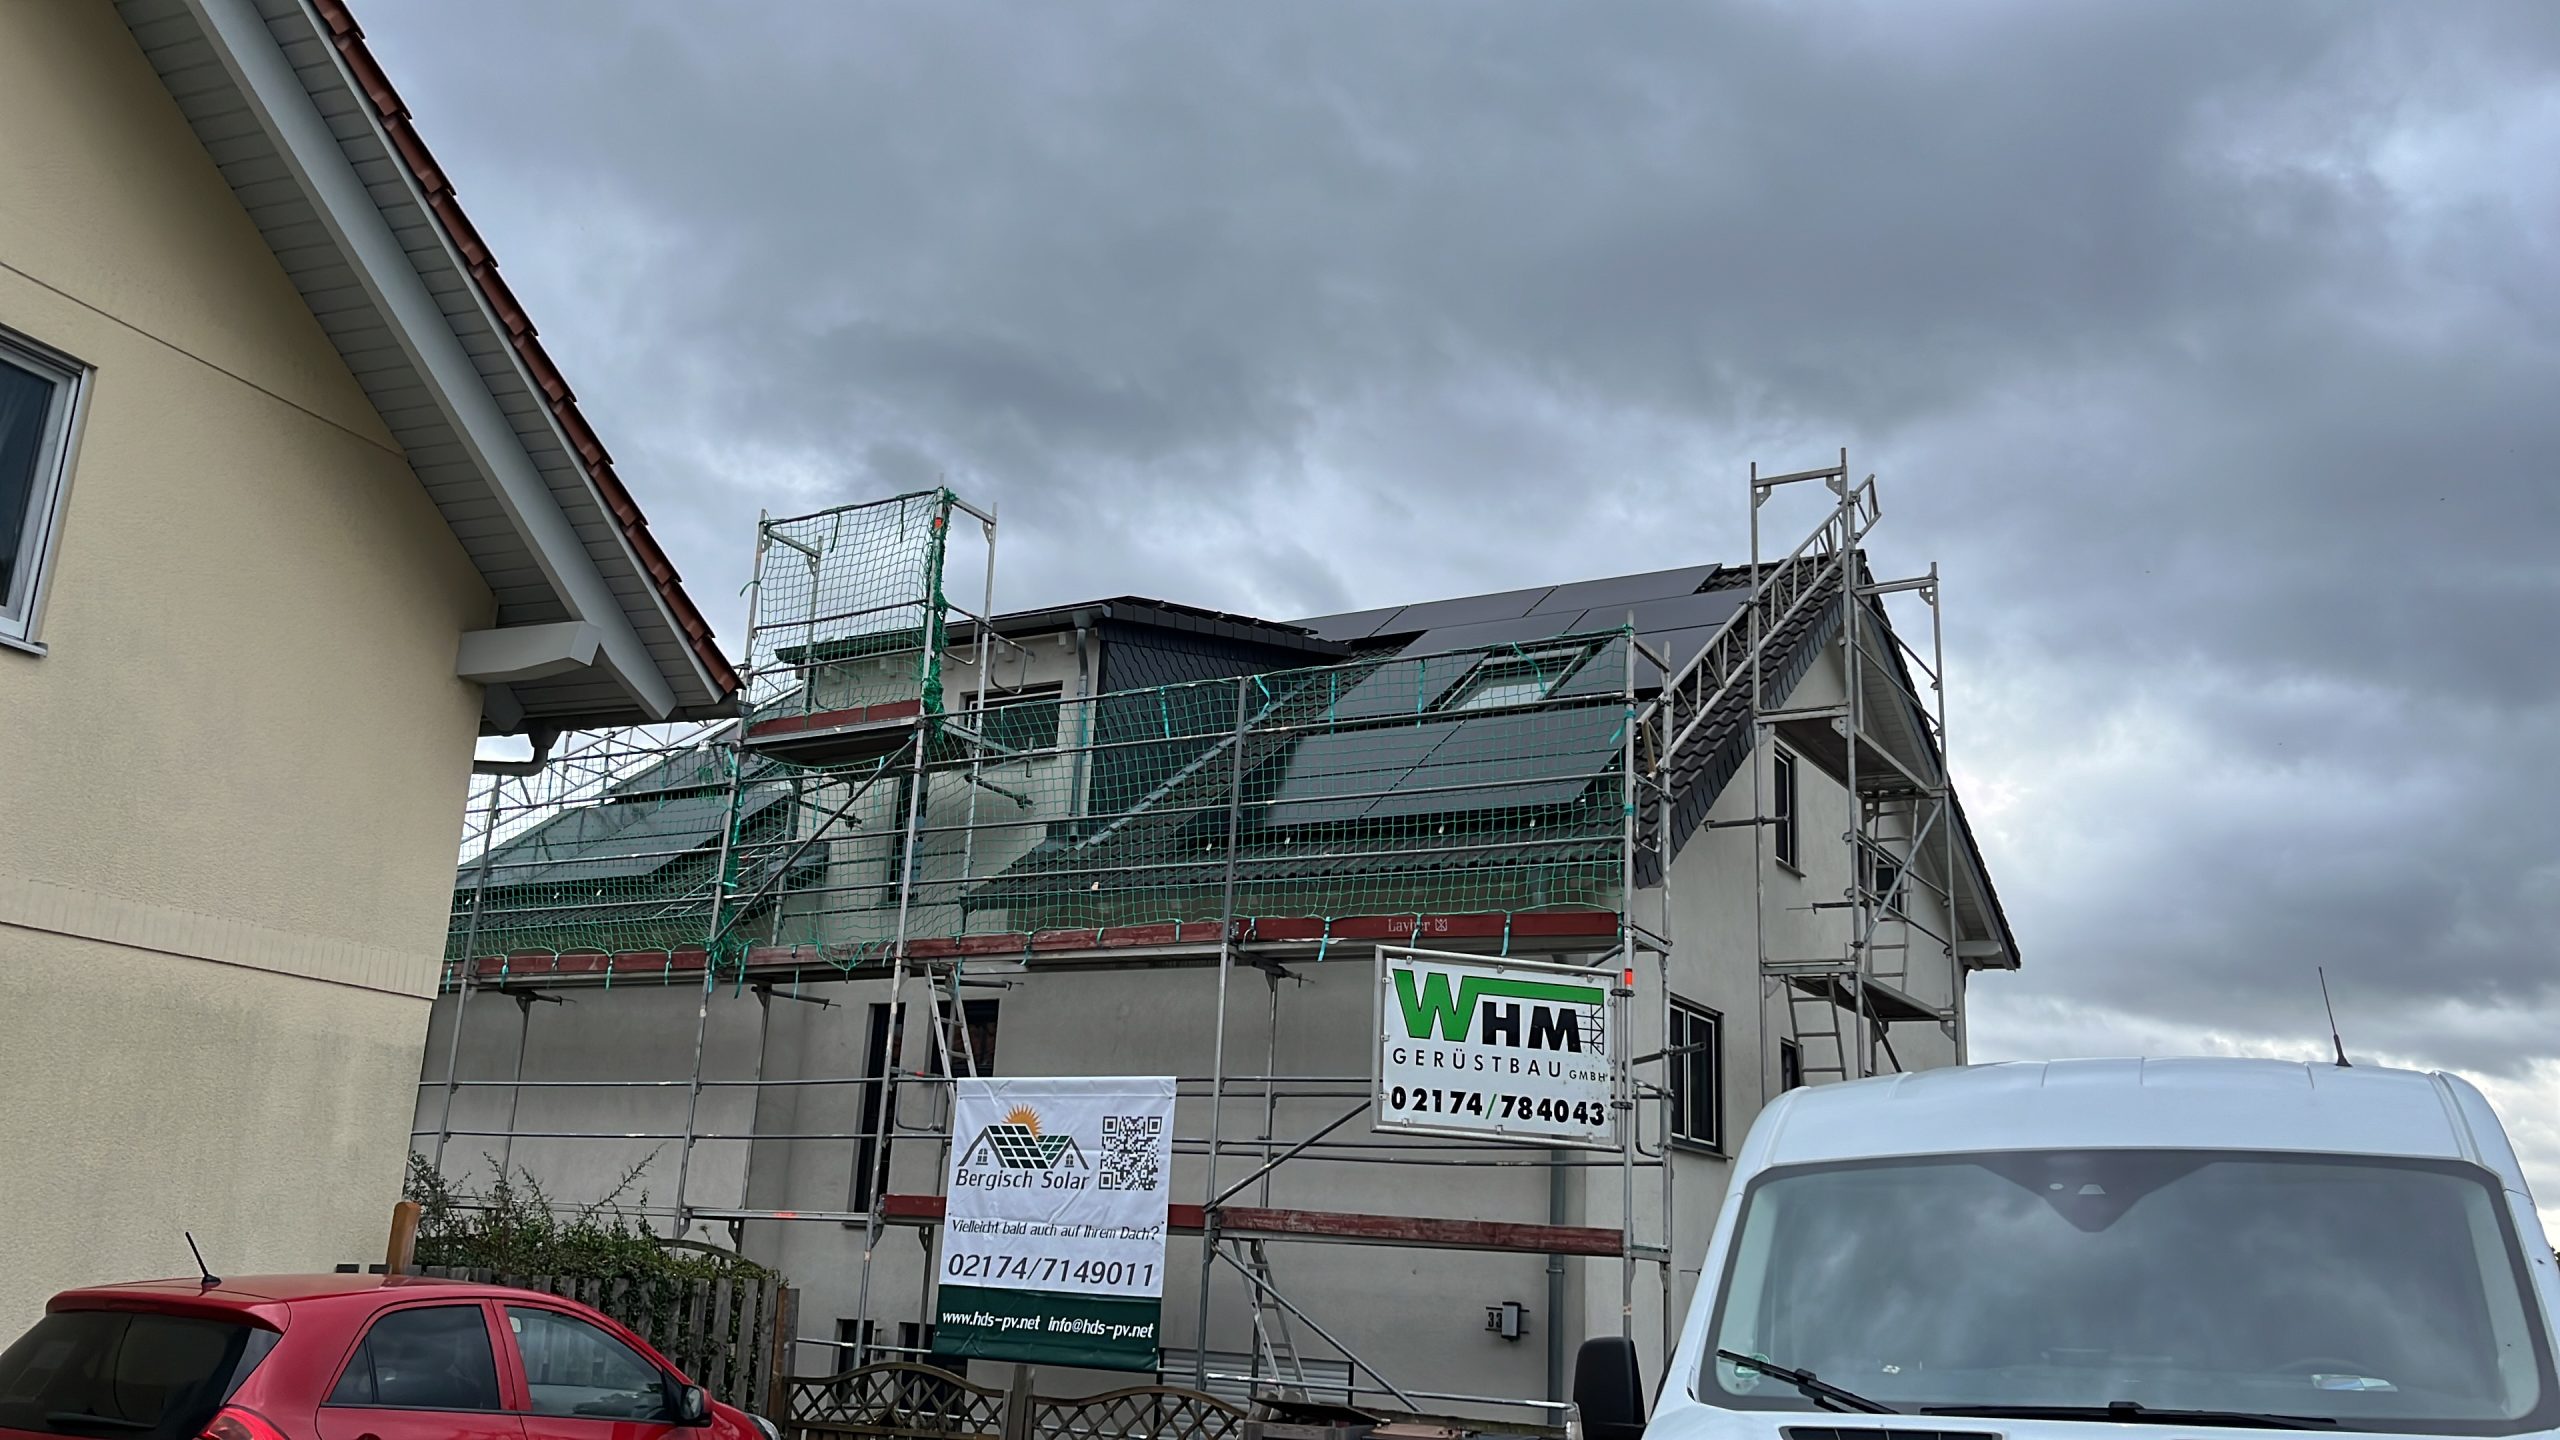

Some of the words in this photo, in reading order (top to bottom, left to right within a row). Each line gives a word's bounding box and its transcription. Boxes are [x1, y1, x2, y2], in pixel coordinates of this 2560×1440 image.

[1392, 968, 1583, 1053] WHM
[1393, 1048, 1561, 1078] GERÜSTBAU
[1569, 1069, 1606, 1082] GMBH
[1391, 1086, 1605, 1126] 02174/784043
[955, 1169, 1033, 1191] Bergisch
[1041, 1171, 1090, 1190] Solar
[952, 1219, 1000, 1234] Vielleicht
[1002, 1222, 1027, 1236] bald
[1030, 1223, 1057, 1237] auch
[1060, 1225, 1080, 1237] auf
[1083, 1226, 1116, 1239] Ihrem
[1120, 1226, 1160, 1241] Dach?
[948, 1253, 1154, 1287] 02174/7149011
[942, 1311, 1041, 1332] www.hds-pv.net
[1047, 1316, 1154, 1340] info@hds-pv.net
